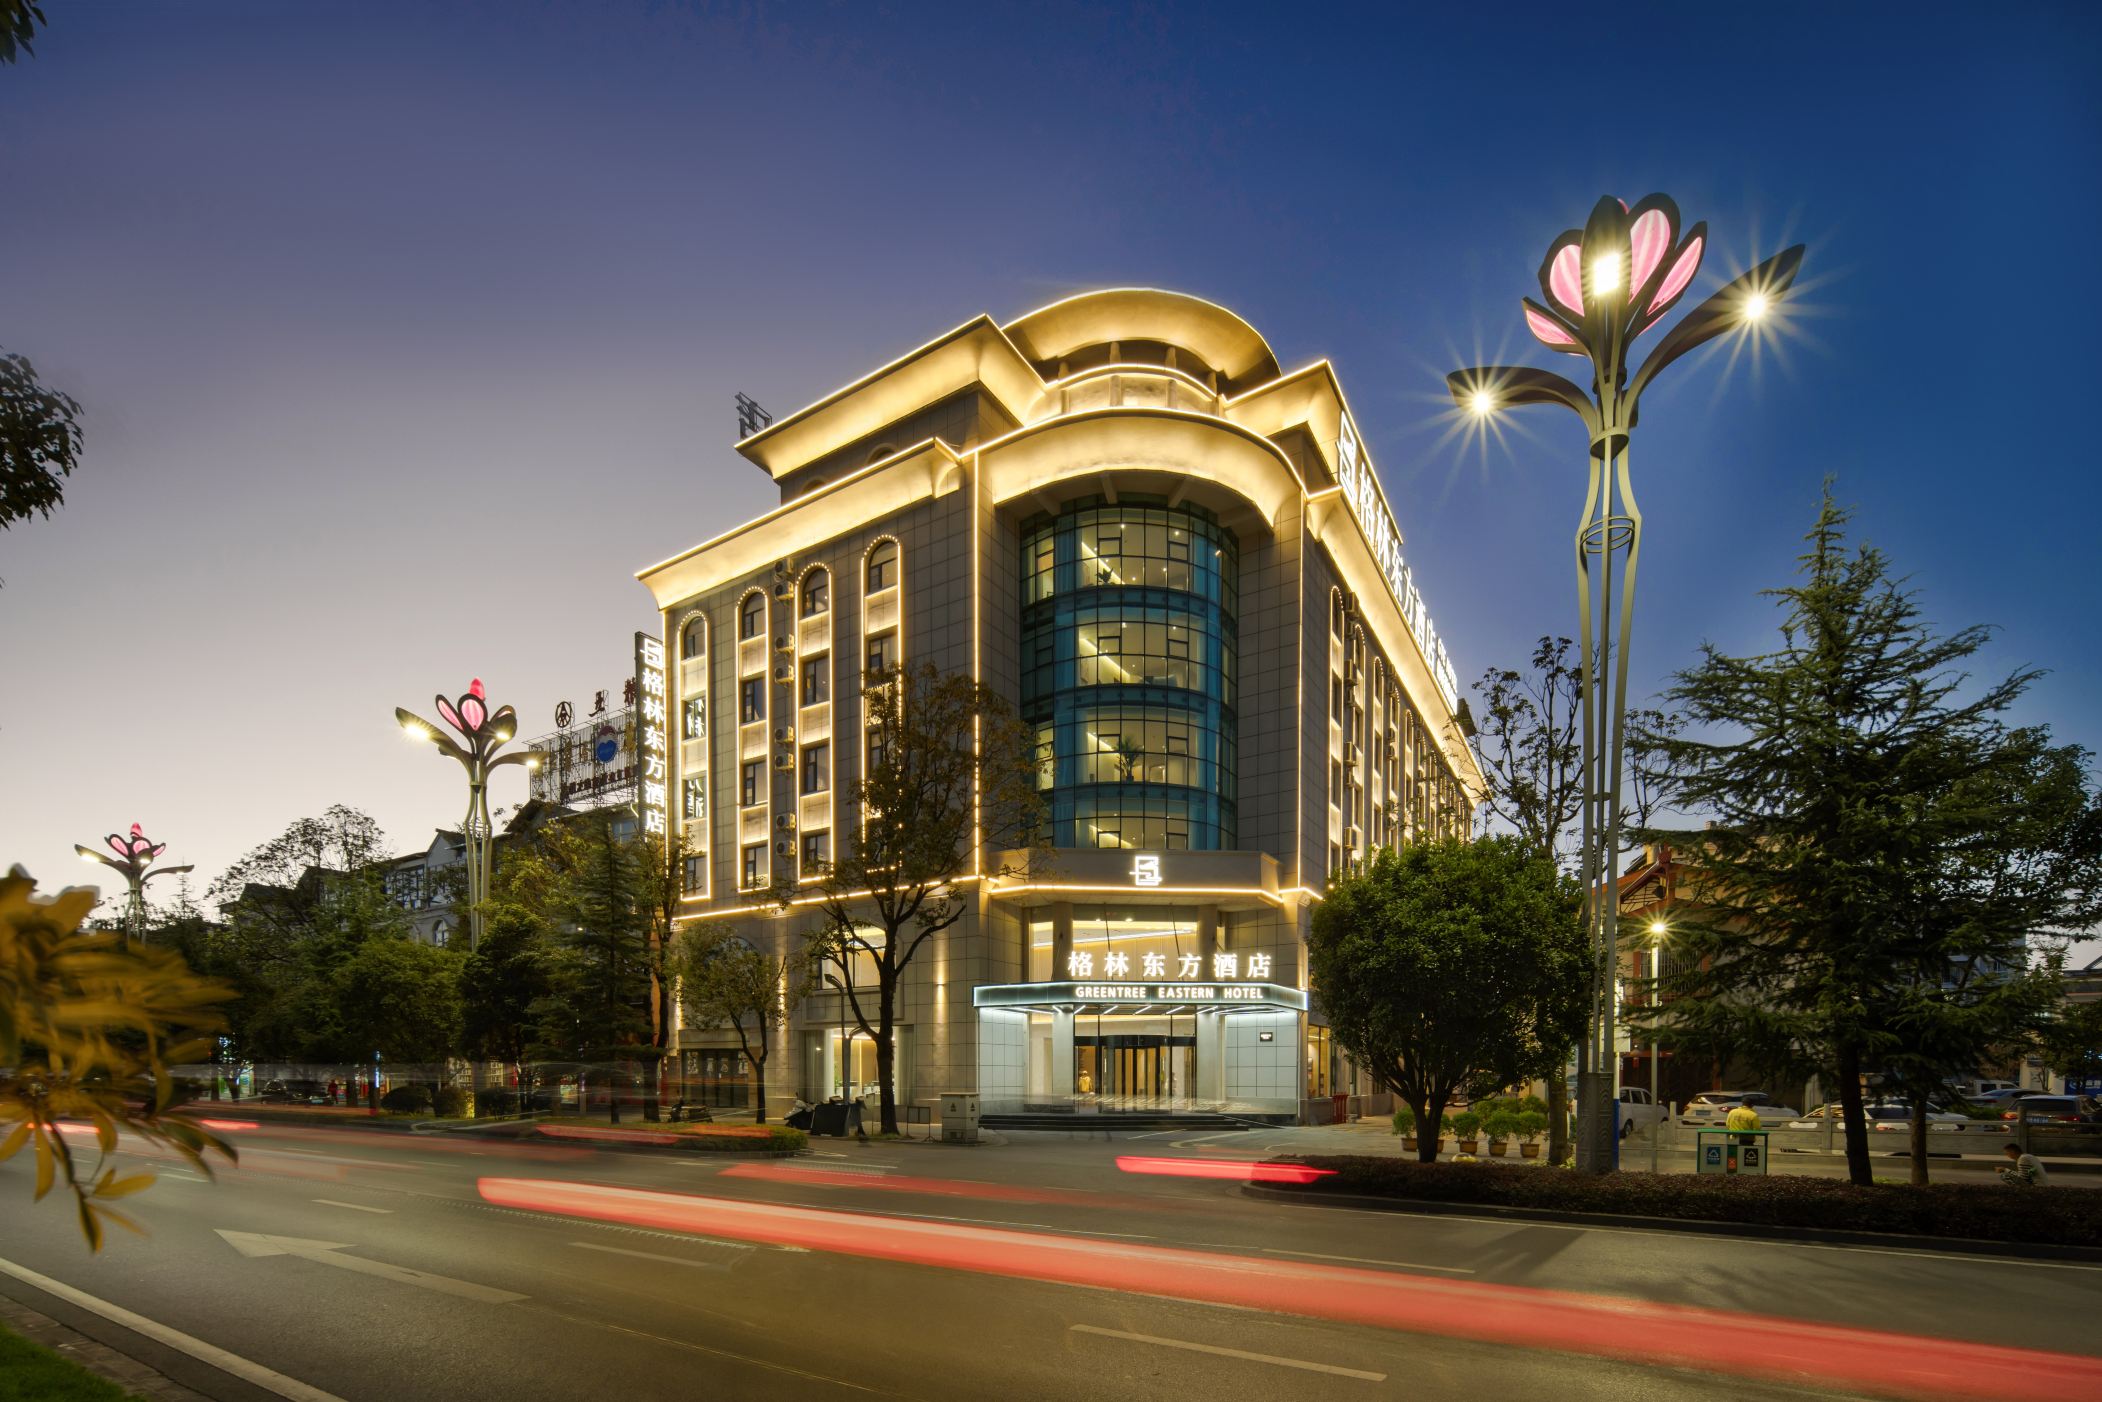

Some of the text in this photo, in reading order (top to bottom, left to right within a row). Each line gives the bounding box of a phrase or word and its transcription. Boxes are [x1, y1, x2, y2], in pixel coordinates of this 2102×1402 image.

[642, 667, 665, 835] 格林东方酒店
[1068, 951, 1271, 978] 格林东方酒店
[1075, 986, 1264, 999] GREENTREE EASTERN HOTEL
